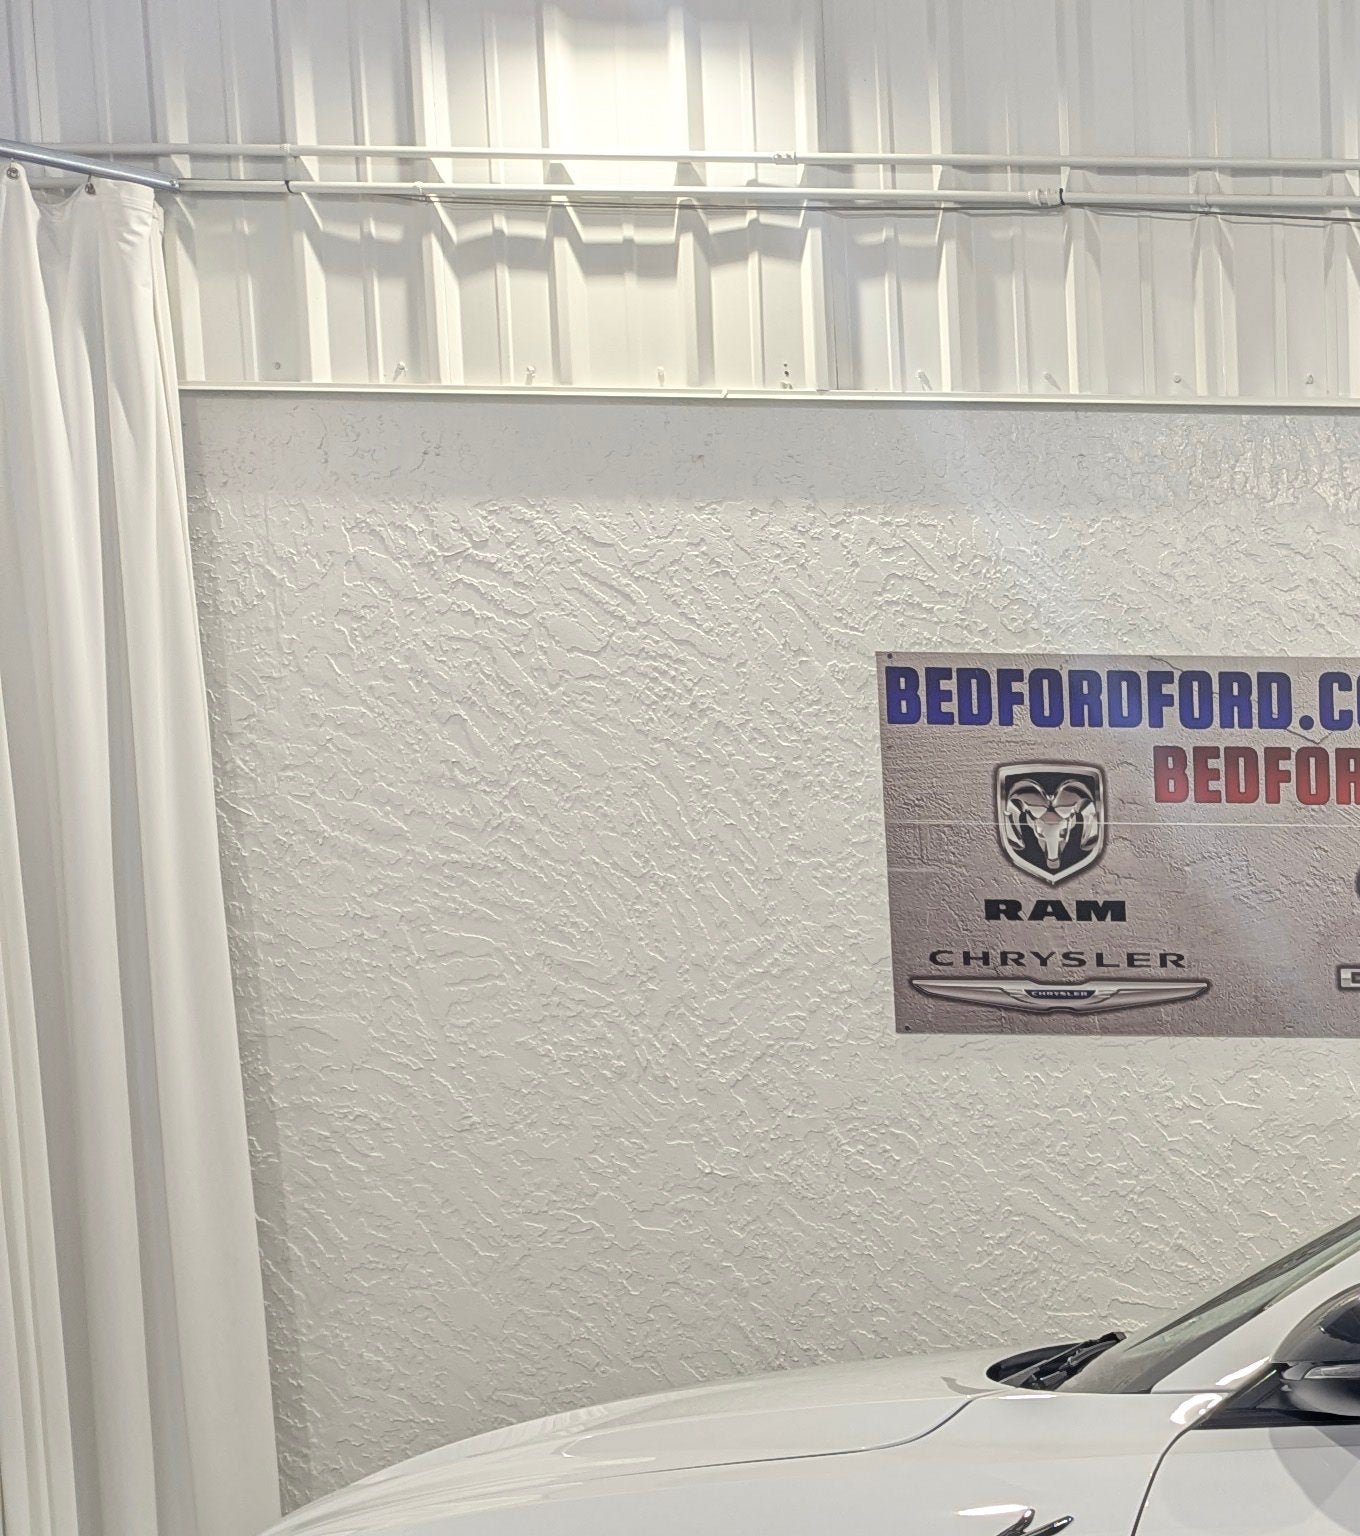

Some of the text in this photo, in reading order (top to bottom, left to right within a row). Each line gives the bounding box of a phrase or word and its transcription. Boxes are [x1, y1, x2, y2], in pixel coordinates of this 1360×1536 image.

[984, 899, 1127, 923] RAM
[929, 950, 1187, 969] CHRYSLER
[1031, 990, 1088, 998] CHRYSLER
